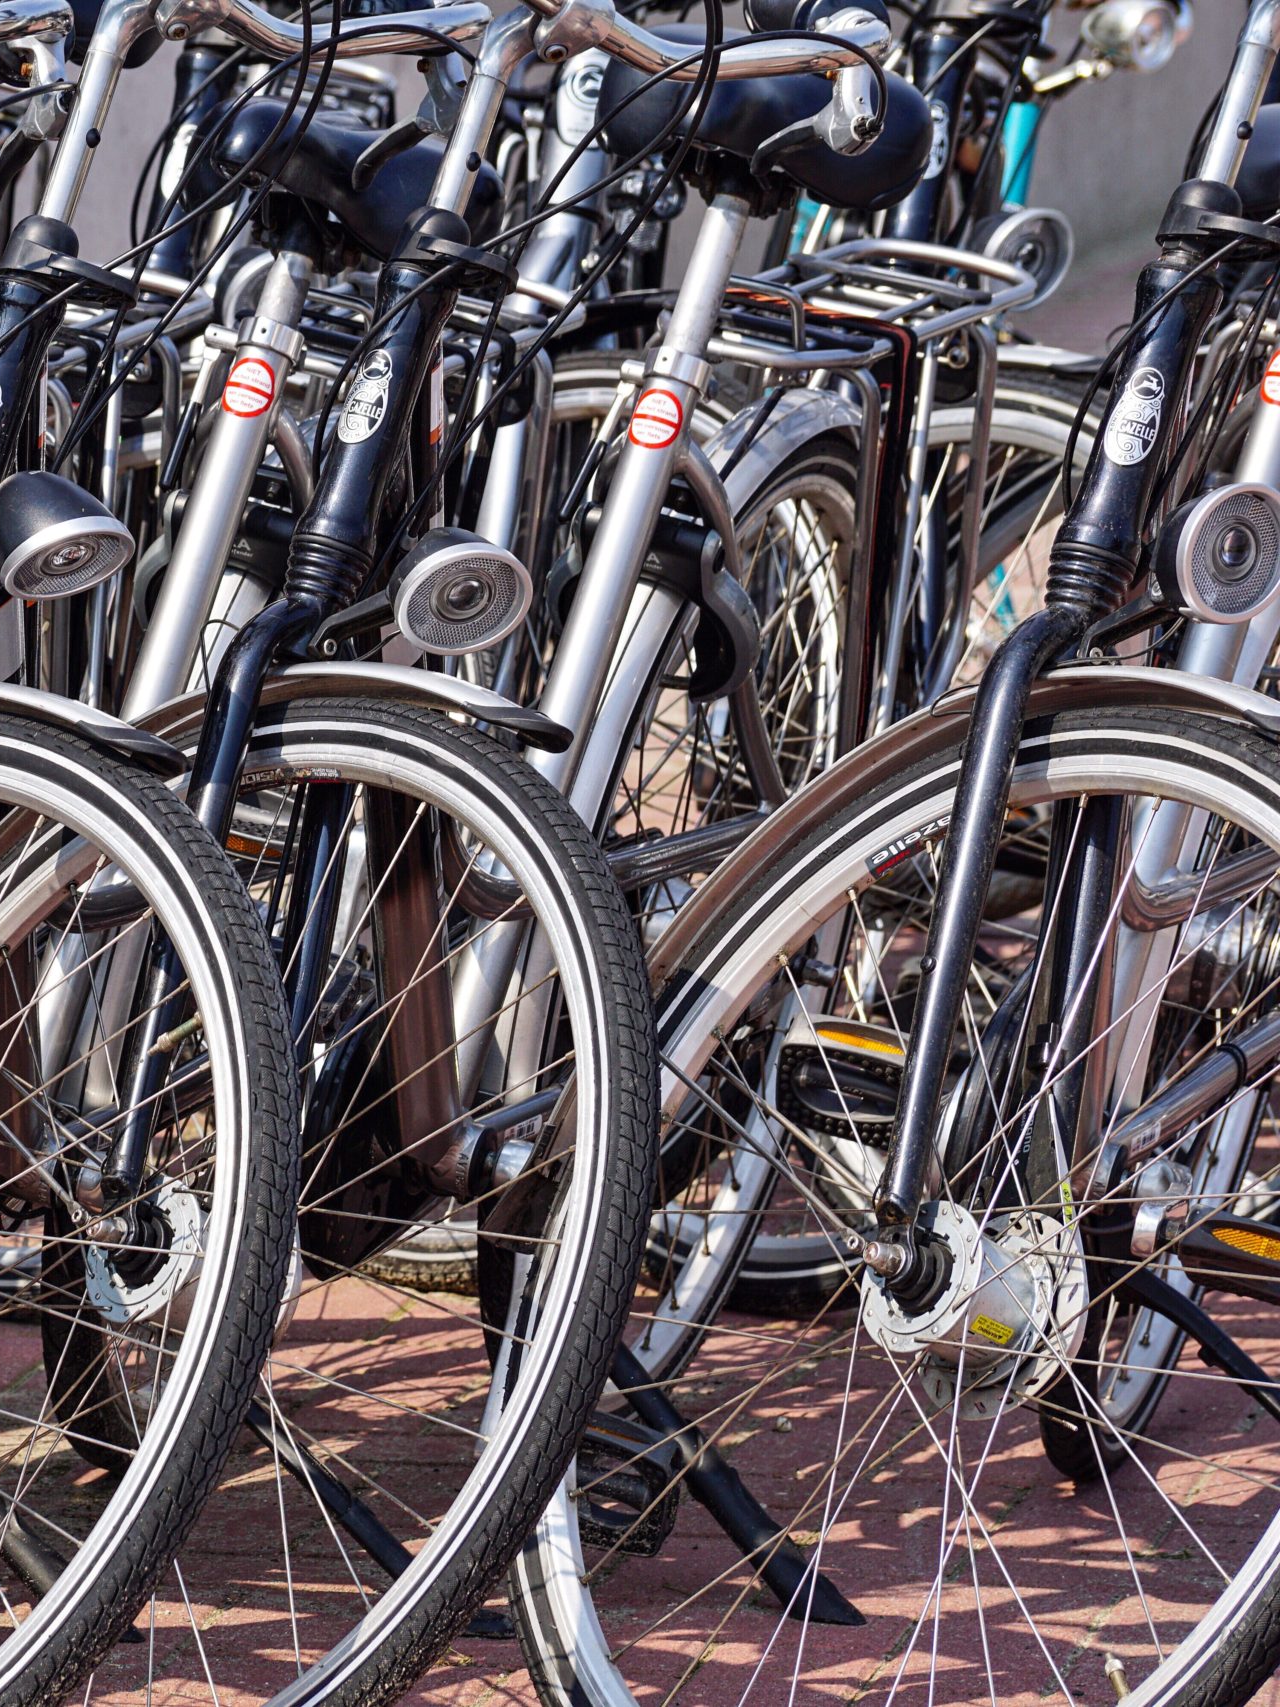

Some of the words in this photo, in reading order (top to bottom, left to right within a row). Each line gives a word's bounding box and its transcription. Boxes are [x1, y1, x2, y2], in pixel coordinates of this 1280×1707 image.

[349, 400, 384, 420] GAZELLE
[1120, 419, 1156, 442] GAZELLE
[872, 814, 951, 865] azelle
